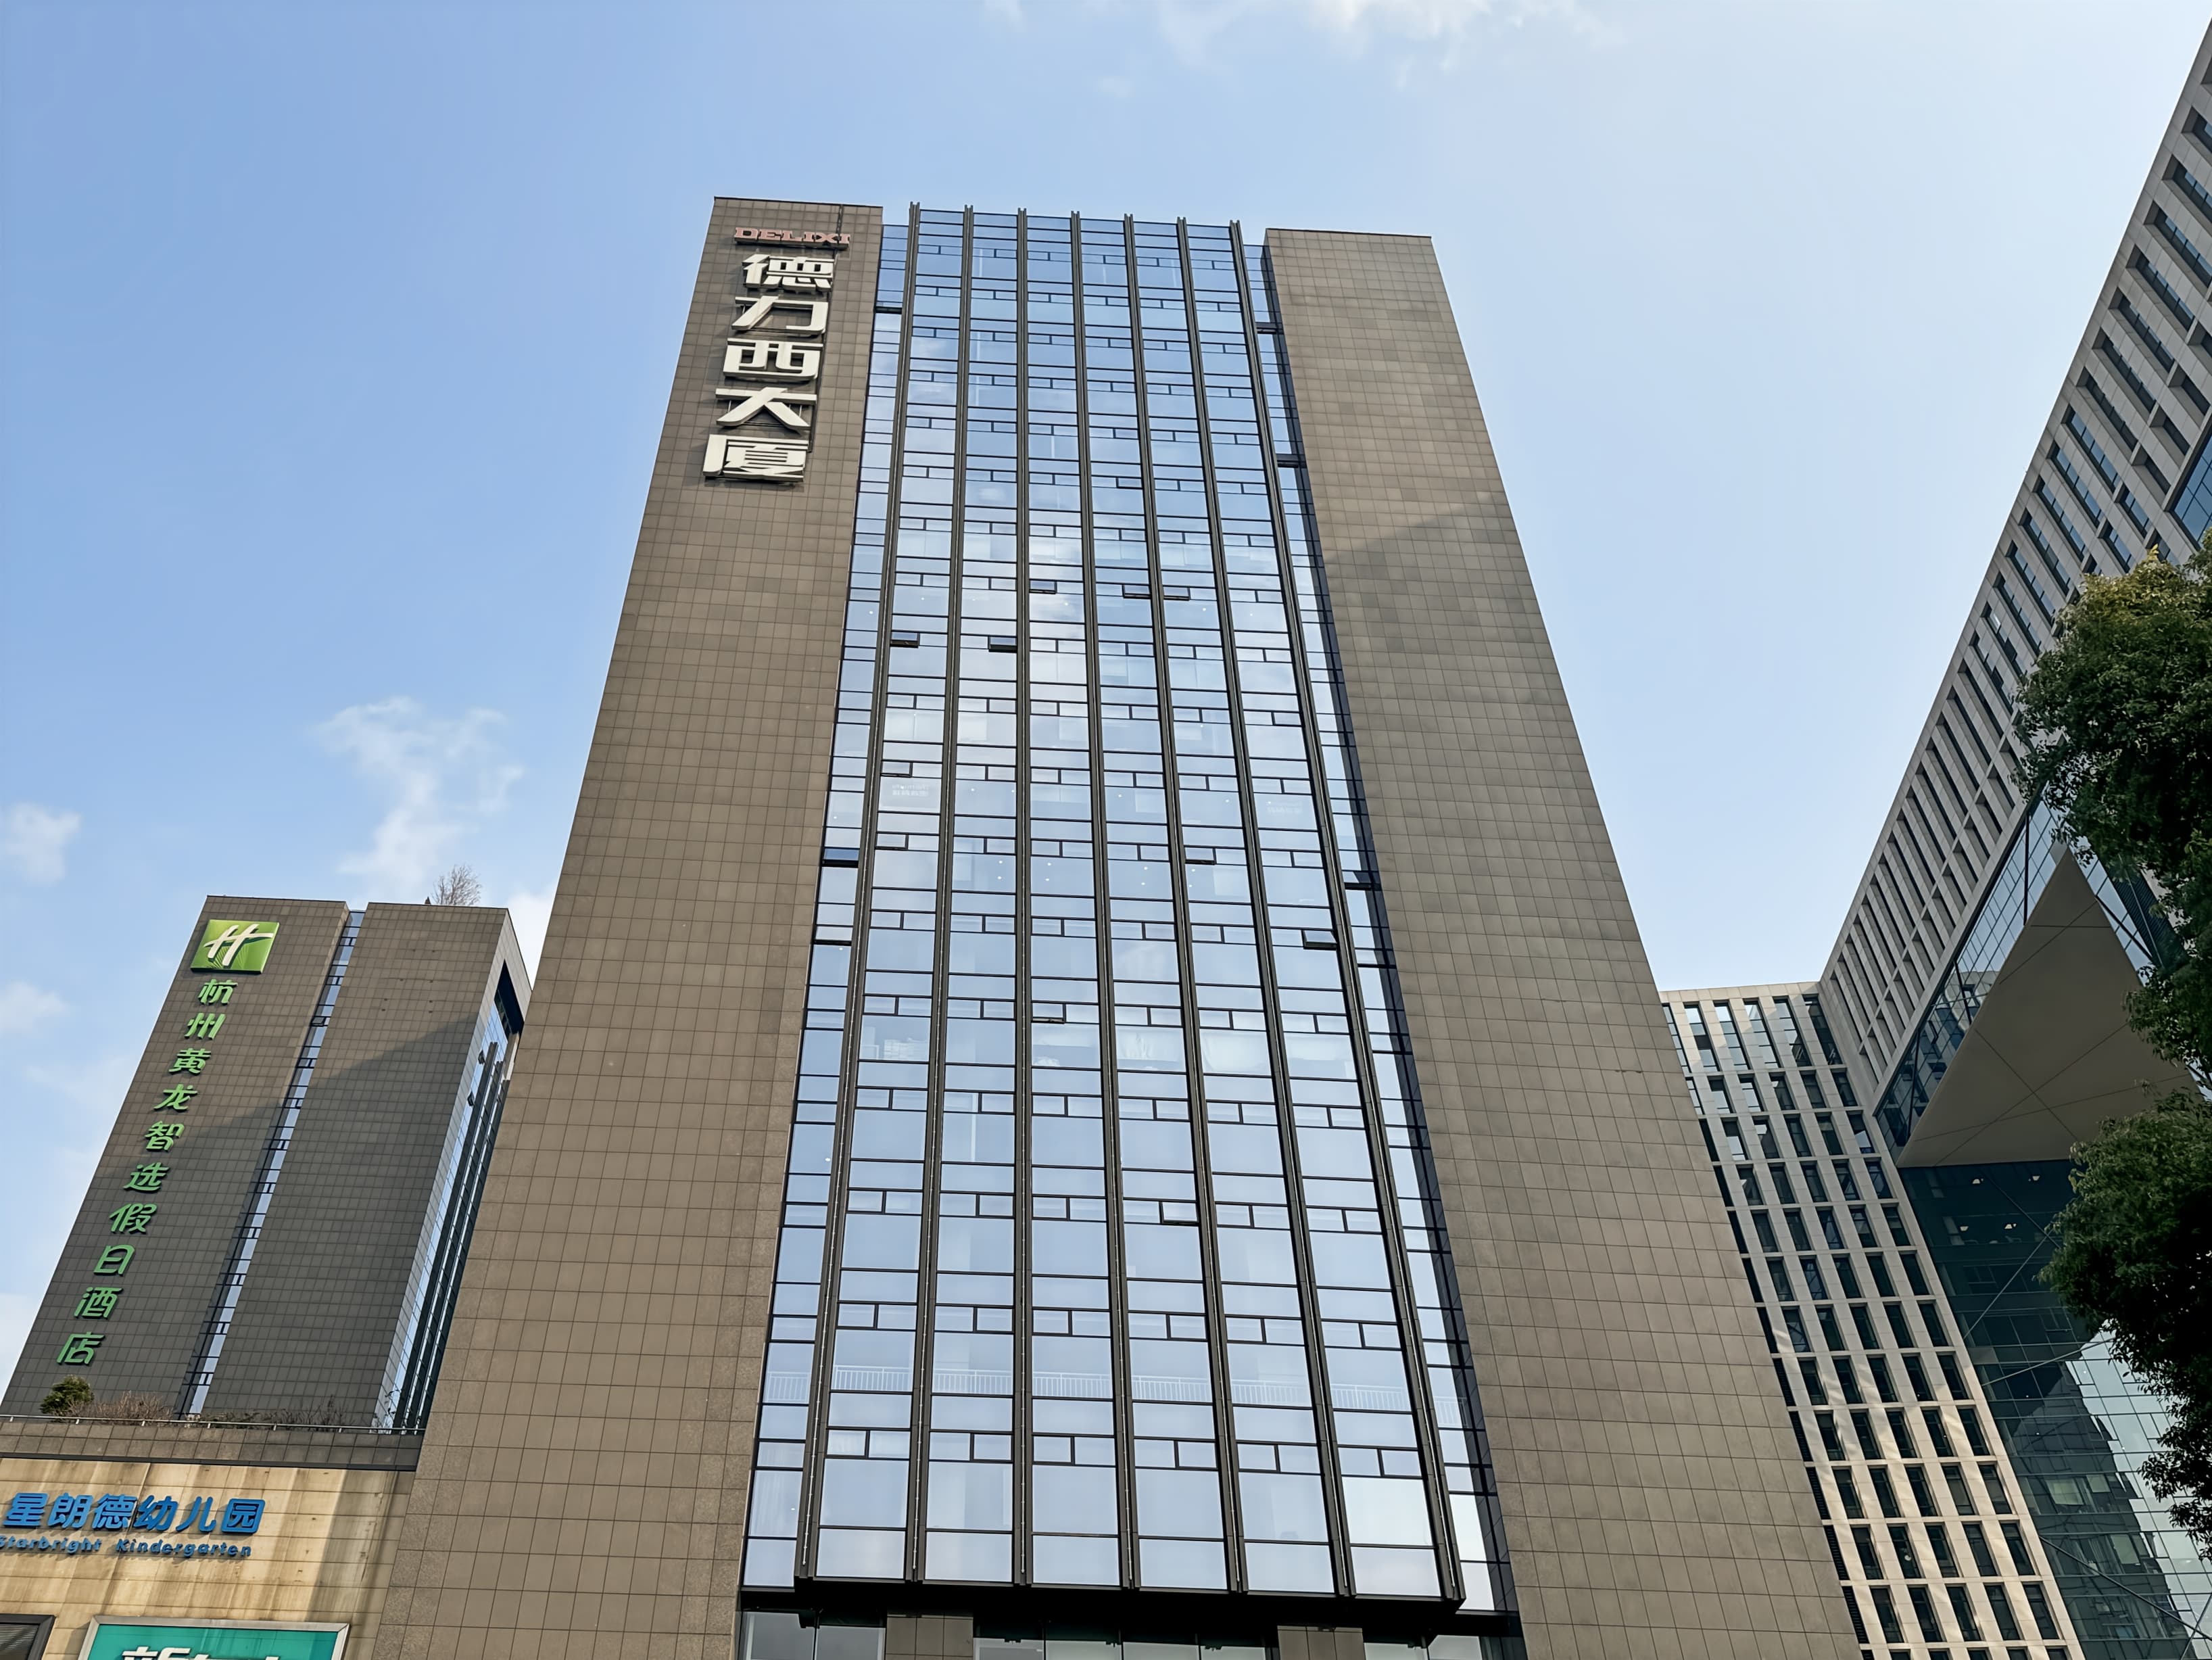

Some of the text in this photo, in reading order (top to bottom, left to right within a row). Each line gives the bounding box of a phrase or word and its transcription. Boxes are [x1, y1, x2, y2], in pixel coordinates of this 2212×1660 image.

[734, 227, 851, 247] DELIXI
[703, 254, 835, 482] 德力西大厦
[57, 978, 238, 1365] 杭州黄龙智选假日酒店
[3, 1492, 266, 1534] 星朗德幼儿园
[0, 1535, 251, 1558] Starbright Kindergarten
